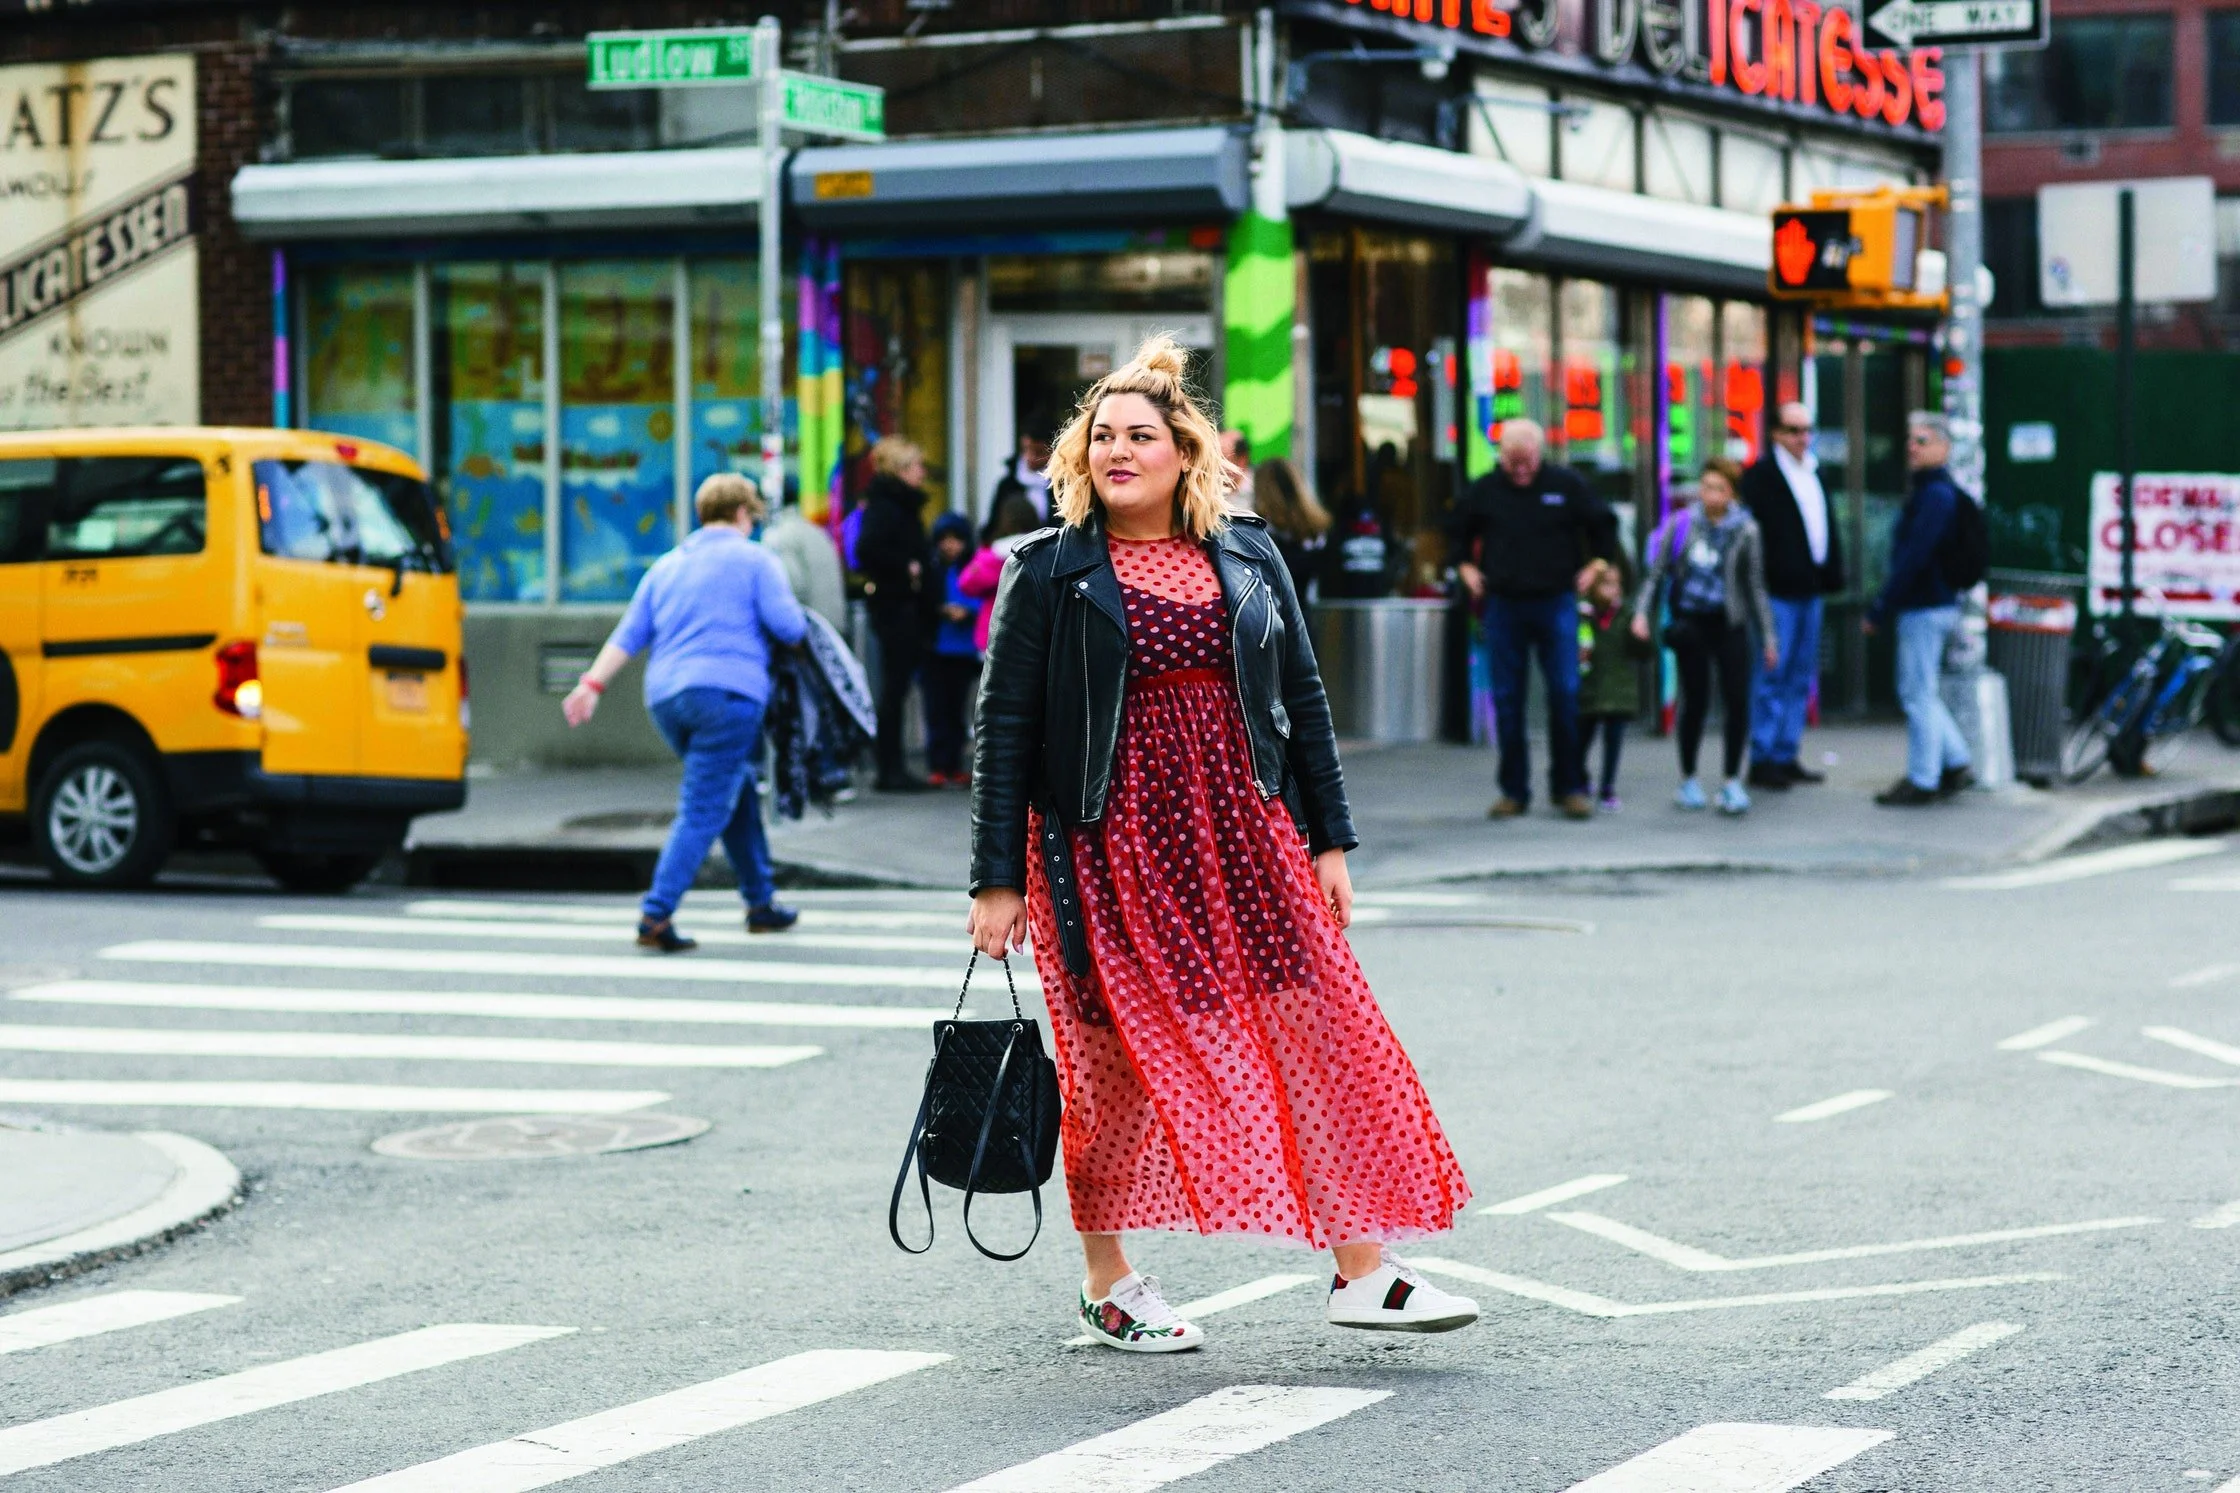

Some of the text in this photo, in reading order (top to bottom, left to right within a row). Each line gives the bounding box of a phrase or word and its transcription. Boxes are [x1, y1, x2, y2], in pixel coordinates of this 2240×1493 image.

[593, 37, 719, 80] Ludlow
[0, 74, 177, 148] ATZ'S
[2100, 519, 2240, 553] CLOSE
